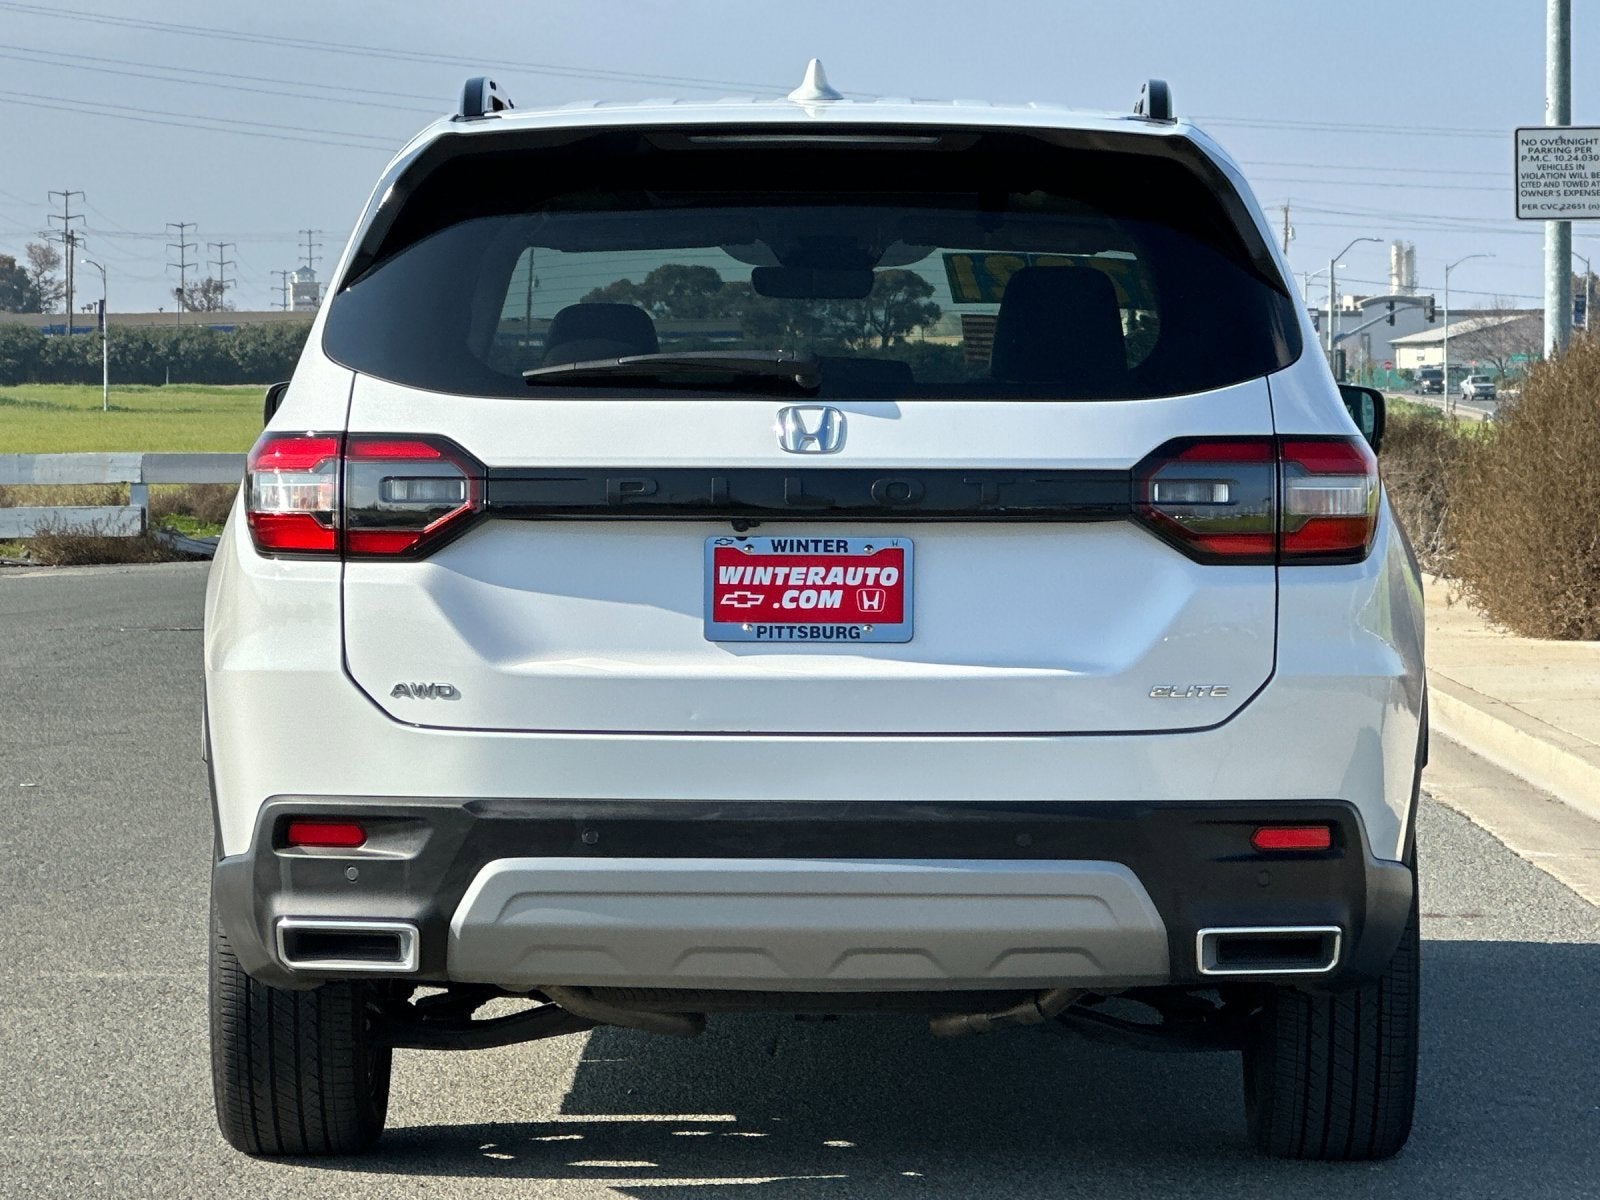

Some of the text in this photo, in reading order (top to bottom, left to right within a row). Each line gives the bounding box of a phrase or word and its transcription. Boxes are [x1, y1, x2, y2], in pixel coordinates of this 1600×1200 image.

[1540, 138, 1599, 146] OVERNIGHT
[606, 477, 1016, 504] PILOT
[771, 540, 848, 553] WINTER
[719, 566, 899, 586] WINTERAUTO
[773, 589, 843, 609] .COM
[757, 626, 861, 639] PITTSBURG
[390, 682, 456, 699] AWD
[1149, 685, 1230, 698] ELITE
